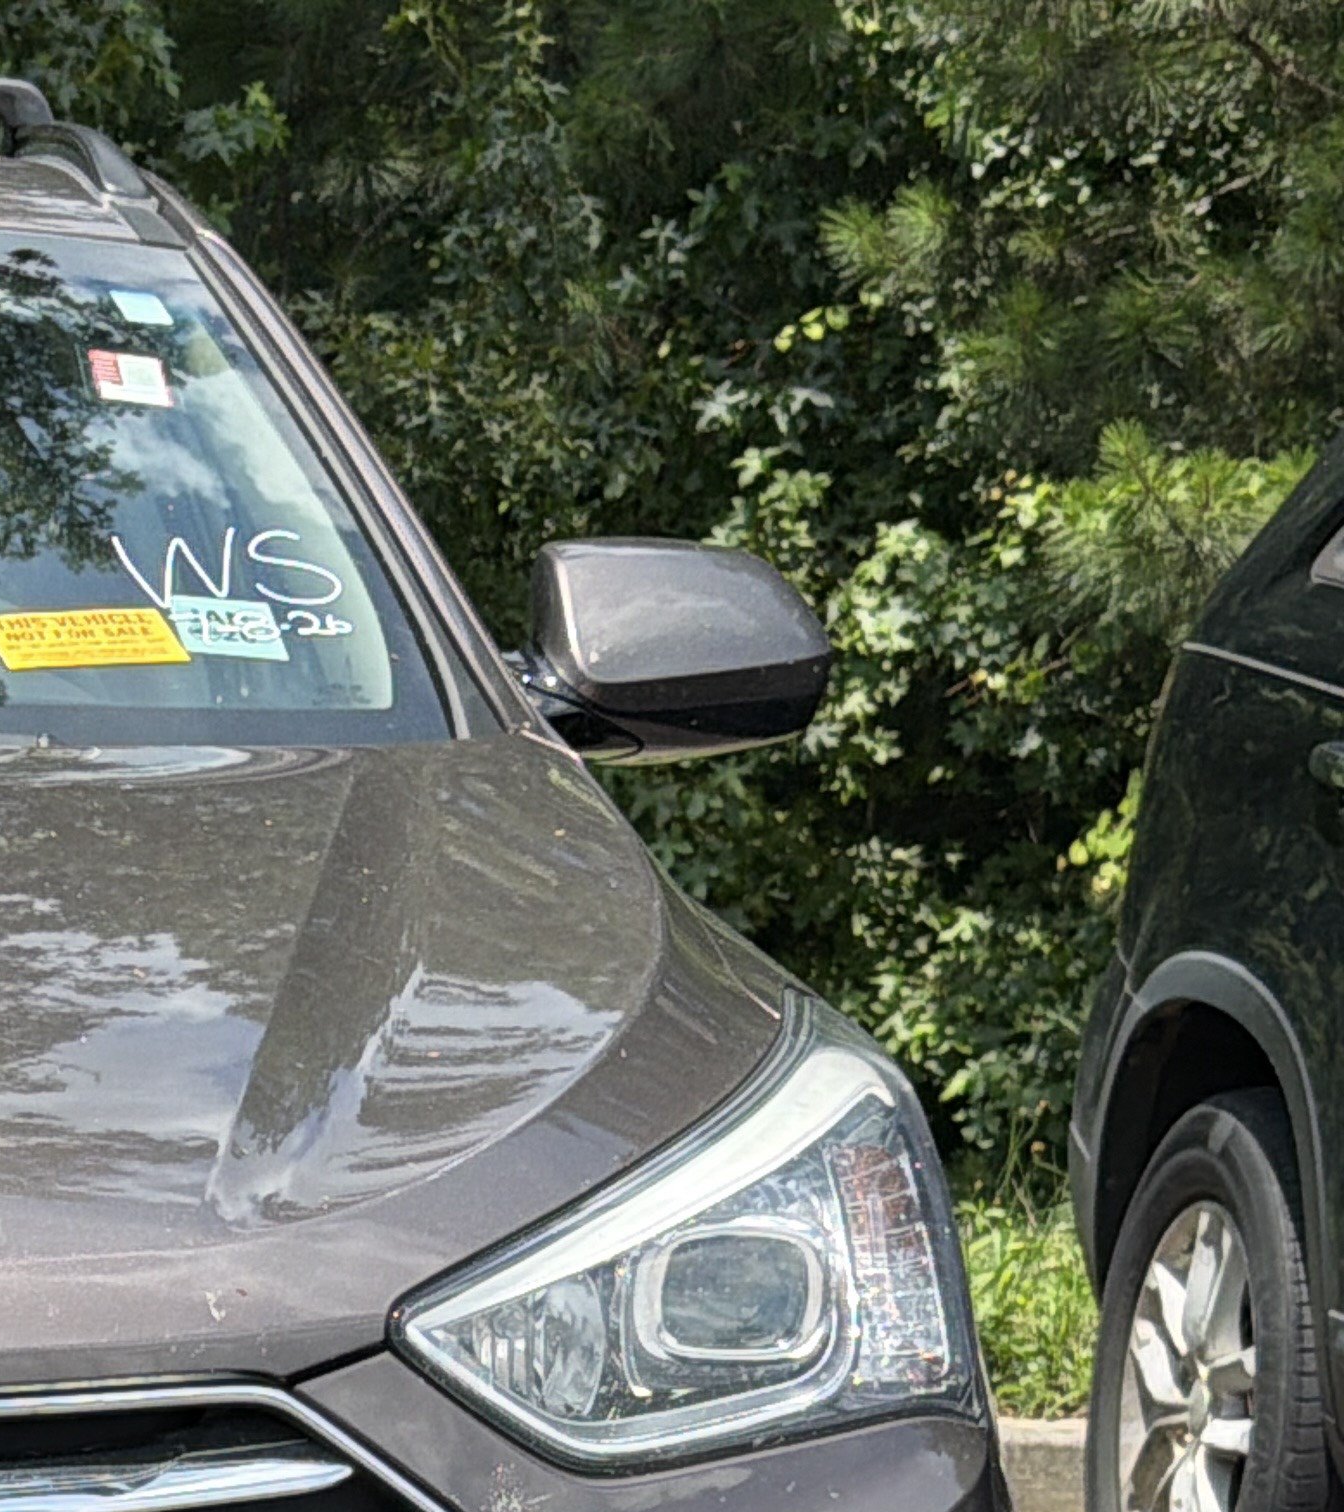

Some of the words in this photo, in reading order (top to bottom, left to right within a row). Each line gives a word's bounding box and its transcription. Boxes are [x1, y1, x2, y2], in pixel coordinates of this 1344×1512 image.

[111, 527, 342, 609] WS
[52, 612, 153, 628] VEHICLE
[5, 630, 47, 642] NOT
[53, 628, 96, 640] FOR
[103, 626, 153, 638] SALE
